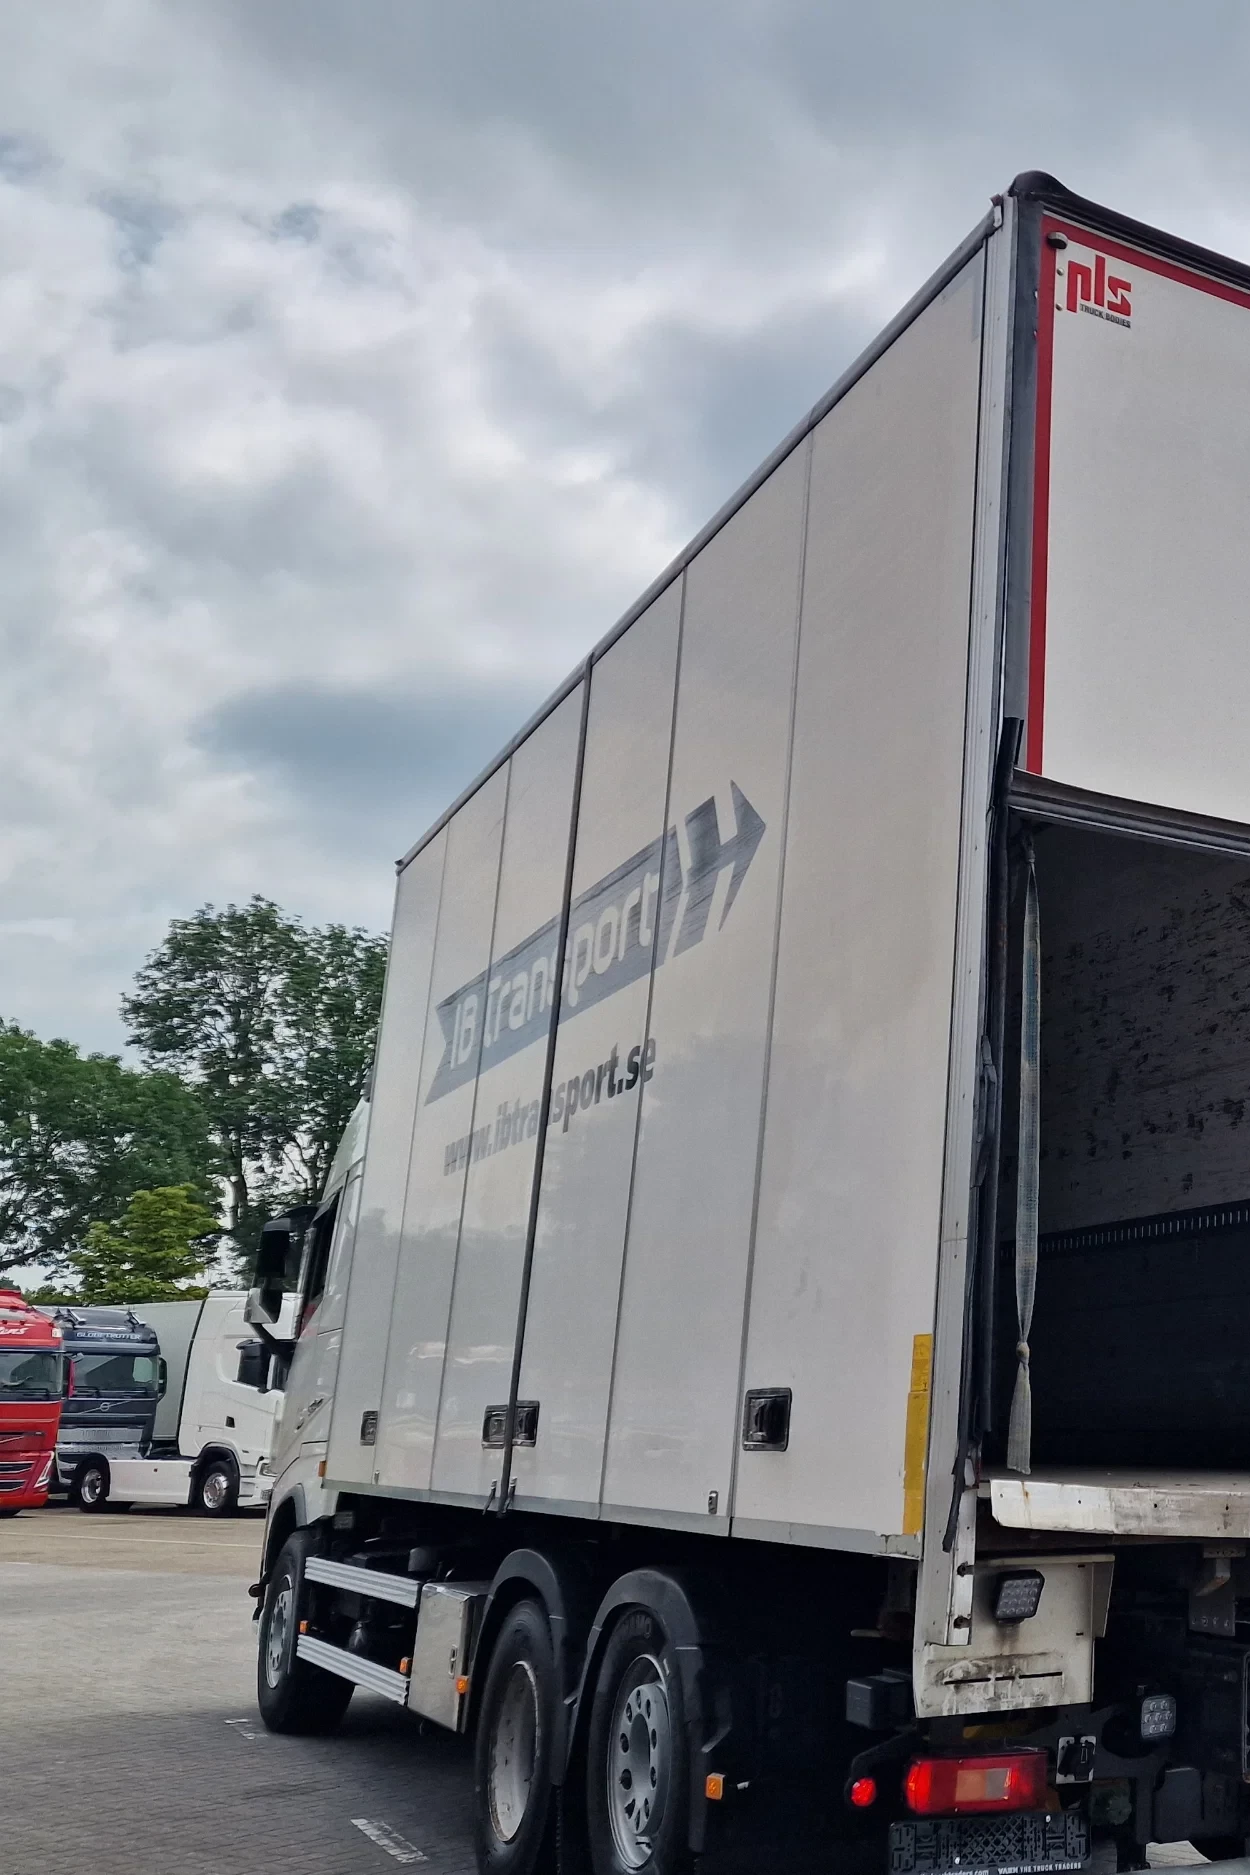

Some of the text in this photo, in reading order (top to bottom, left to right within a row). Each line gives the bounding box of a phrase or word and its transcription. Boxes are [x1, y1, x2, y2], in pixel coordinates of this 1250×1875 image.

[1067, 254, 1132, 317] pls
[1080, 303, 1131, 328] TRUCK BODIES
[450, 994, 478, 1070] IB
[1020, 1865, 1032, 1873] THE
[1033, 1863, 1053, 1873] TRUCK
[1055, 1861, 1082, 1871] TRADERS
